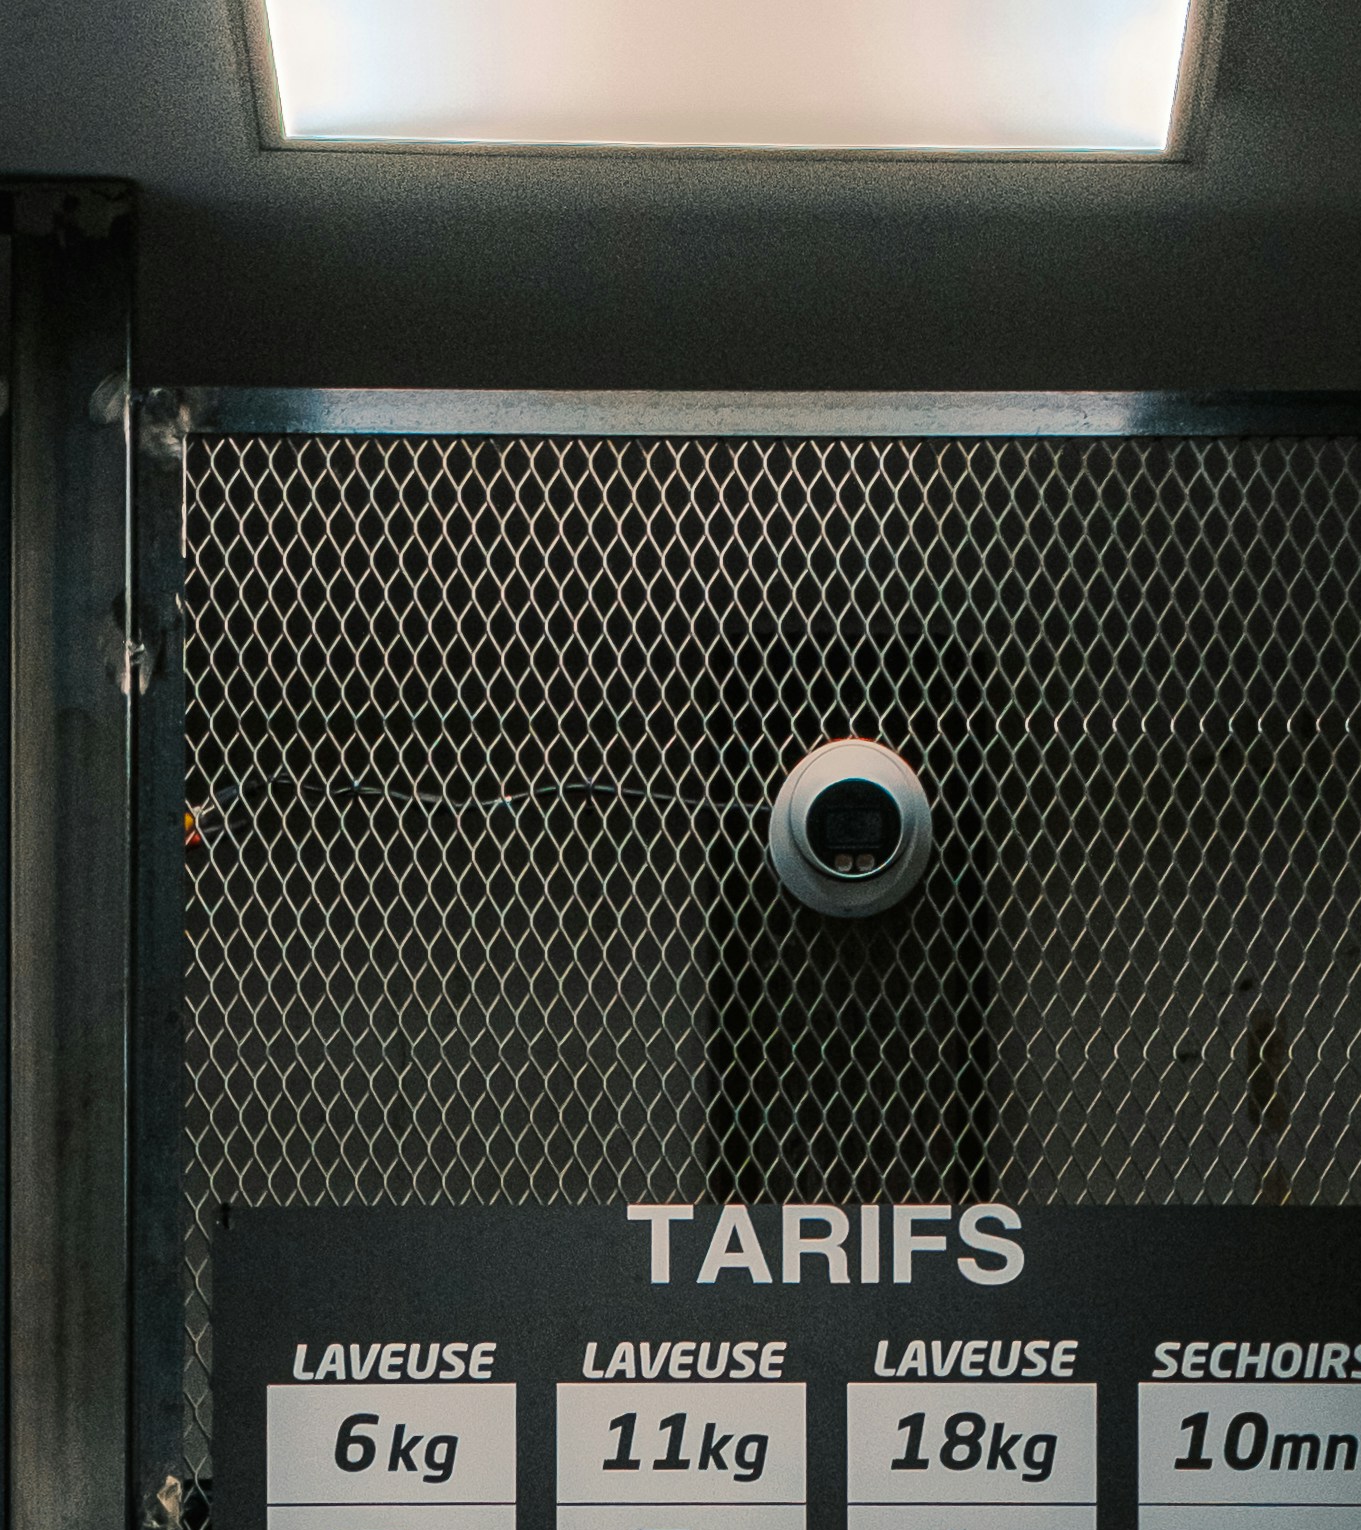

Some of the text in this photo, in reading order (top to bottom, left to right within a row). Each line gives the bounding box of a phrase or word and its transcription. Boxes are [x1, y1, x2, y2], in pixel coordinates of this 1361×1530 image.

[627, 1203, 1025, 1285] TARIFS
[292, 1343, 497, 1381] LAVEUSE
[582, 1341, 787, 1379] LAVEUSE
[873, 1340, 1079, 1378] LAVEUSE
[600, 1411, 770, 1484] 11kg
[890, 1410, 1058, 1484] 18kg
[1175, 1410, 1360, 1474] 10mn
